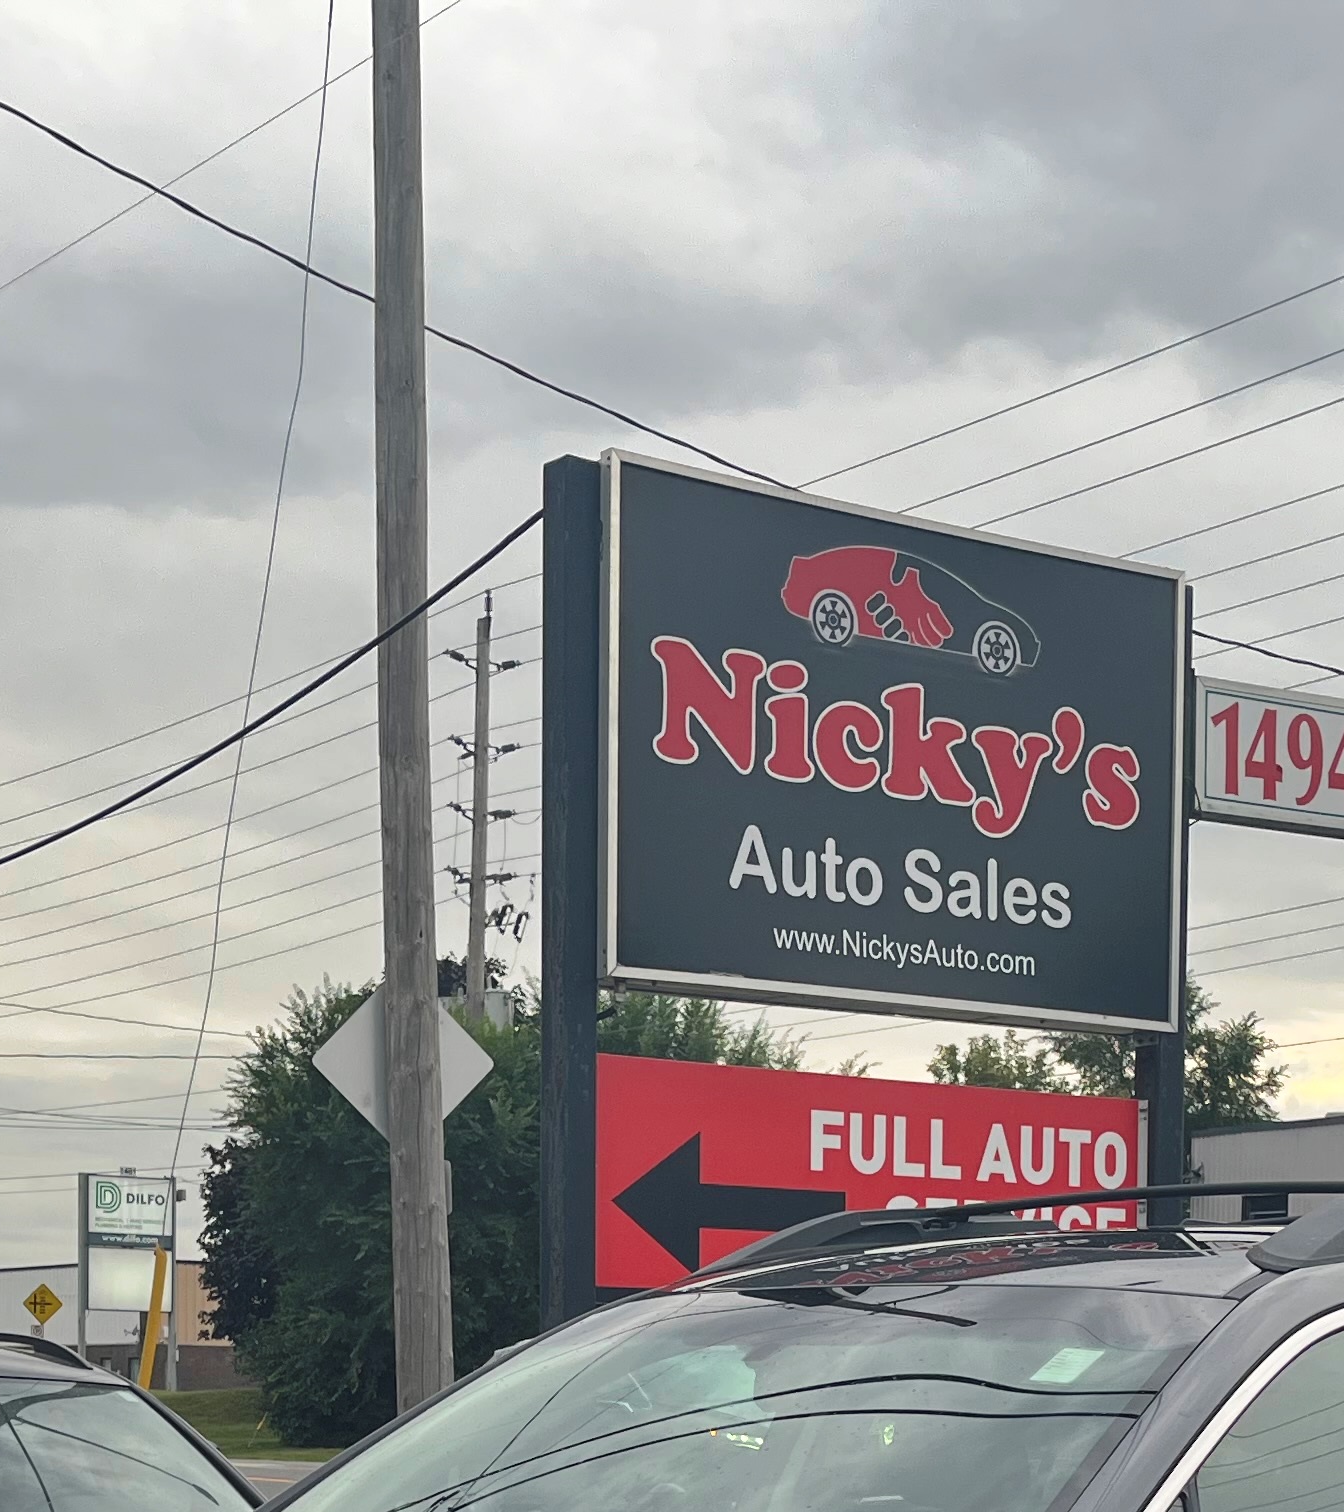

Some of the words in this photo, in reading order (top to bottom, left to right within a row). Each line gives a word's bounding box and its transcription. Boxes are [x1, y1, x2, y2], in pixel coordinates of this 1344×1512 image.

[650, 635, 1141, 838] Nicky's
[728, 824, 884, 907] Auto
[903, 848, 1072, 929] Sales
[773, 927, 1036, 977] www.NickysAuto.com
[810, 1109, 962, 1181] FULL
[976, 1123, 1128, 1190] AUTO
[126, 1193, 165, 1206] DILFO
